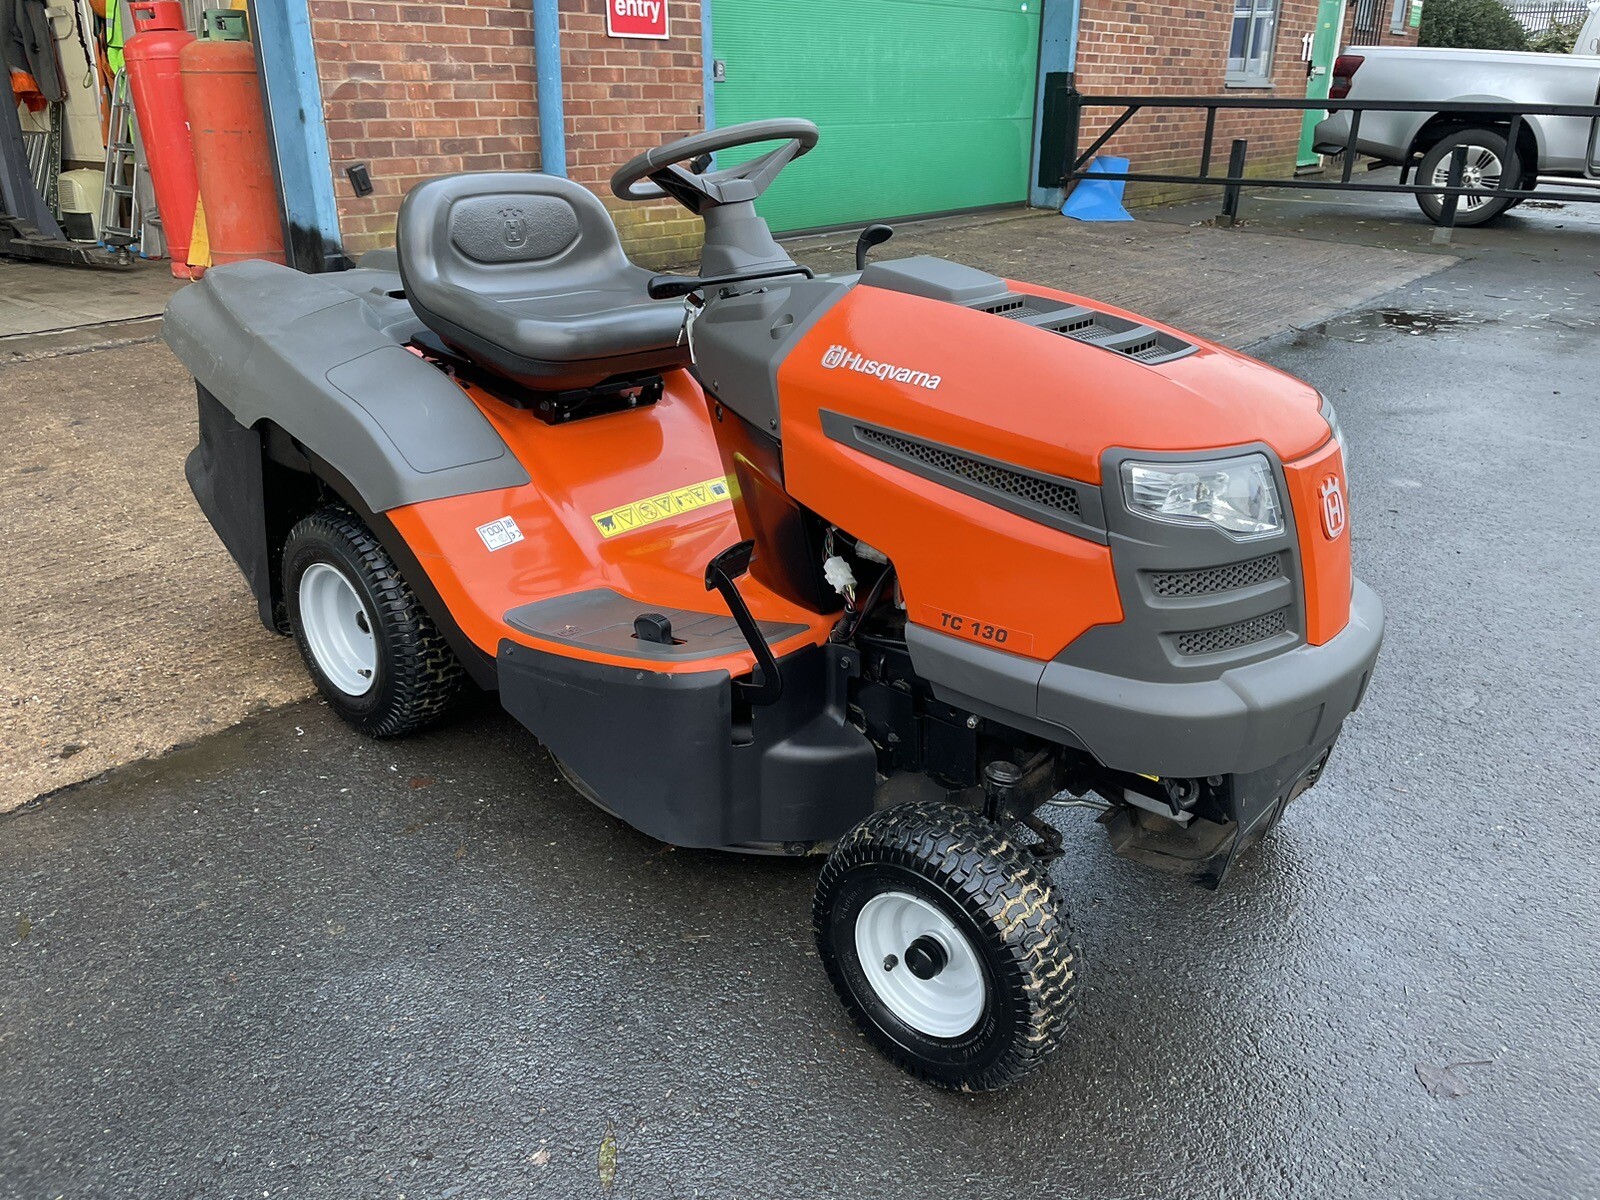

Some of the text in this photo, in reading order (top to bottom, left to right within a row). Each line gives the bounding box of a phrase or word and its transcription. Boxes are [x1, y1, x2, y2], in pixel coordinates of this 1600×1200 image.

[614, 0, 661, 24] entry
[840, 351, 941, 390] Husqvarna
[941, 612, 1008, 643] TC 130
